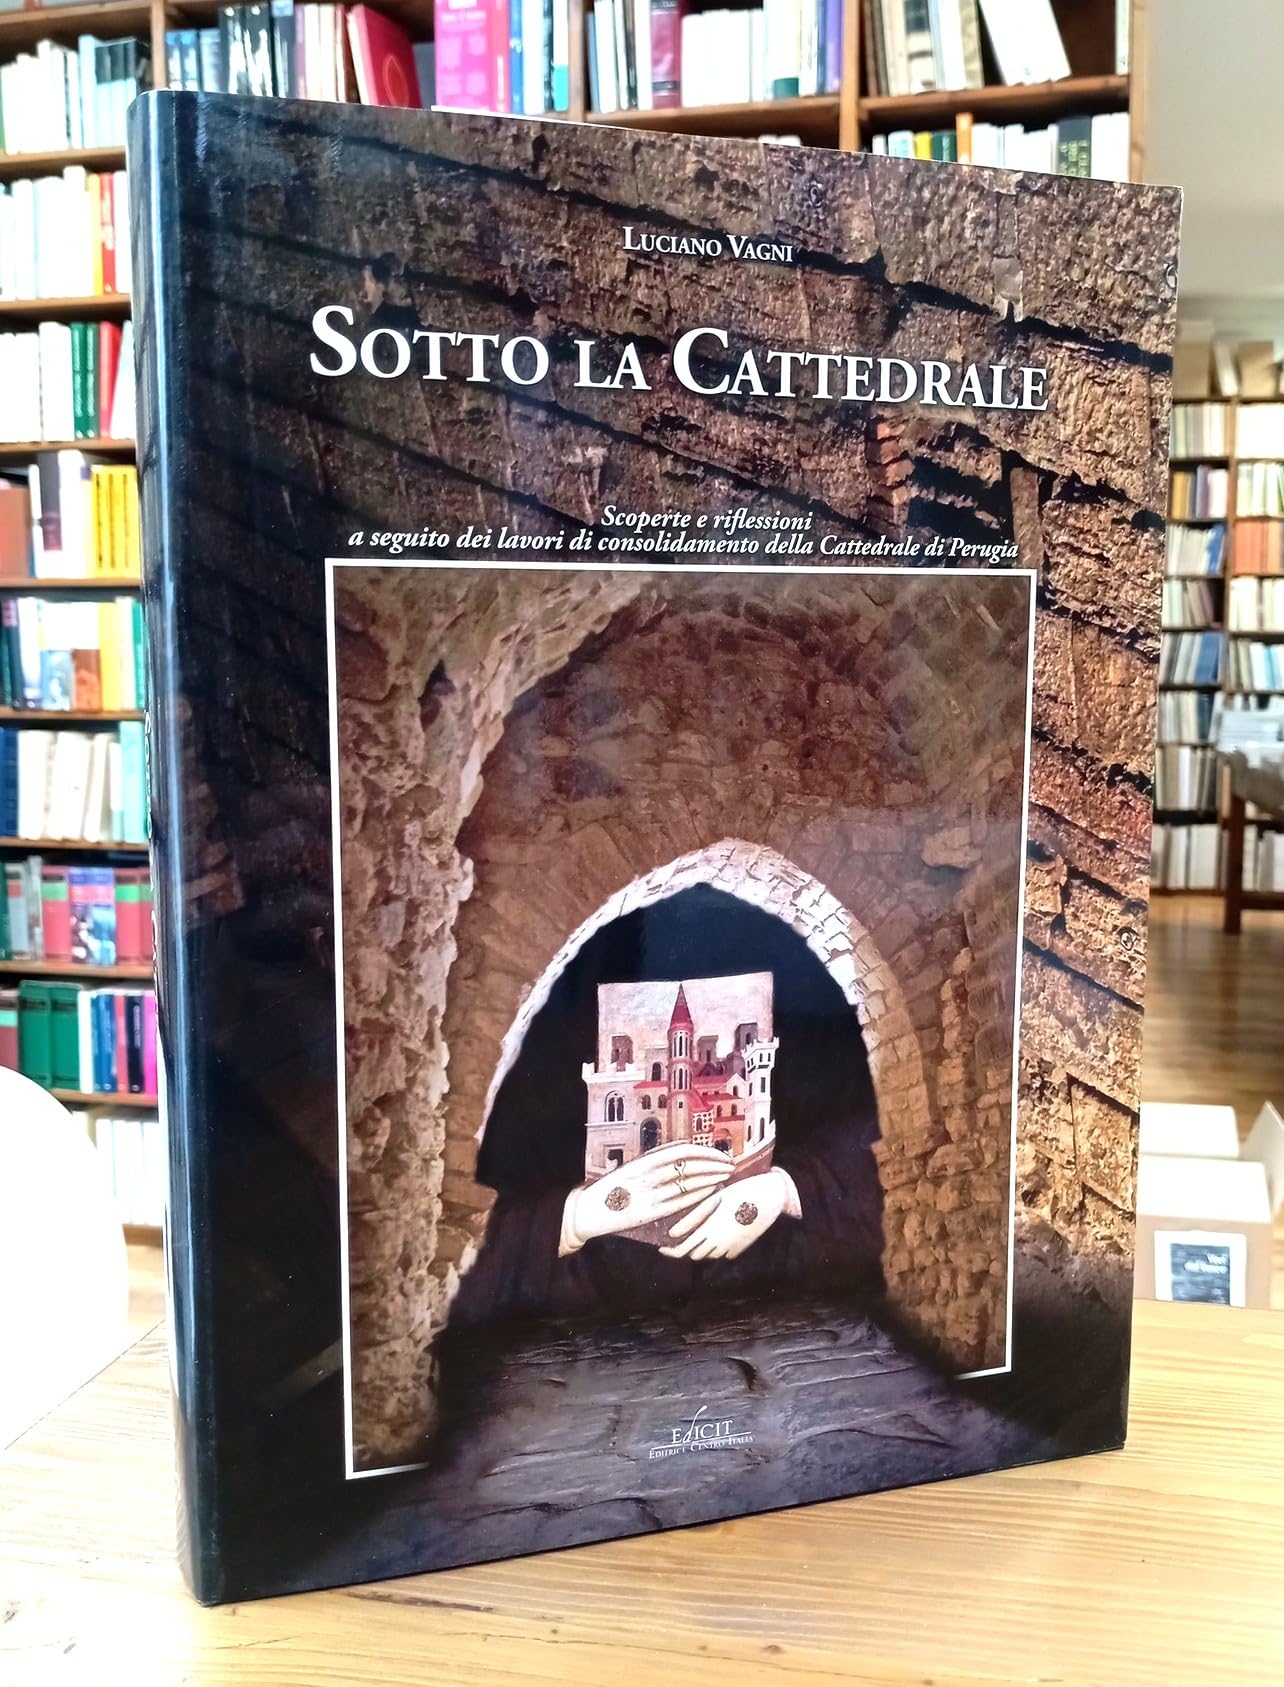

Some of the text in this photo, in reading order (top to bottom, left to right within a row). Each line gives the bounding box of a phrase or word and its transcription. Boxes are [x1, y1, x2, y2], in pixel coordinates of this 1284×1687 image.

[622, 226, 793, 262] LUCIANO VAGNI
[309, 304, 1049, 412] SOTTO LA CATTEDRALE
[601, 505, 814, 536] Scoperte e riflessioni
[348, 526, 1019, 564] a seguito dei lavori di consolidamento della Cattedrale di Perugia
